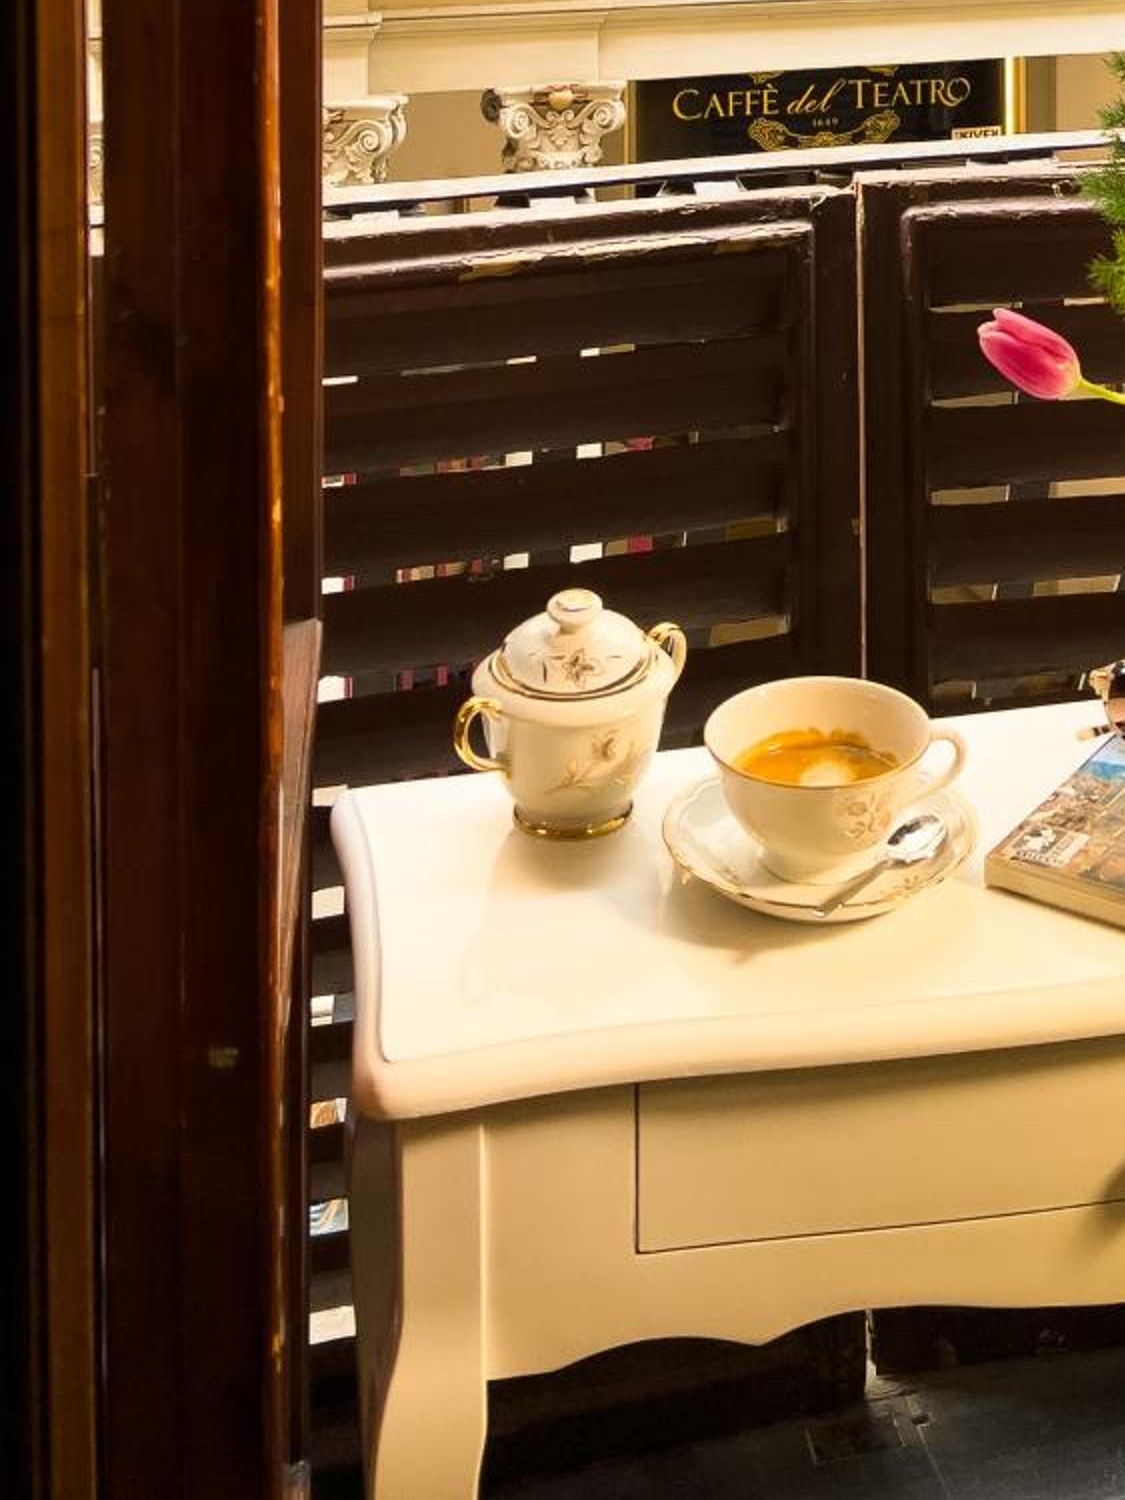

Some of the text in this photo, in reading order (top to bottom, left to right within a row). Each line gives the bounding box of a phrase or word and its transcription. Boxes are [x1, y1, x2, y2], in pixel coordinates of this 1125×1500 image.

[672, 77, 971, 121] CAFFÈ del TEATRO
